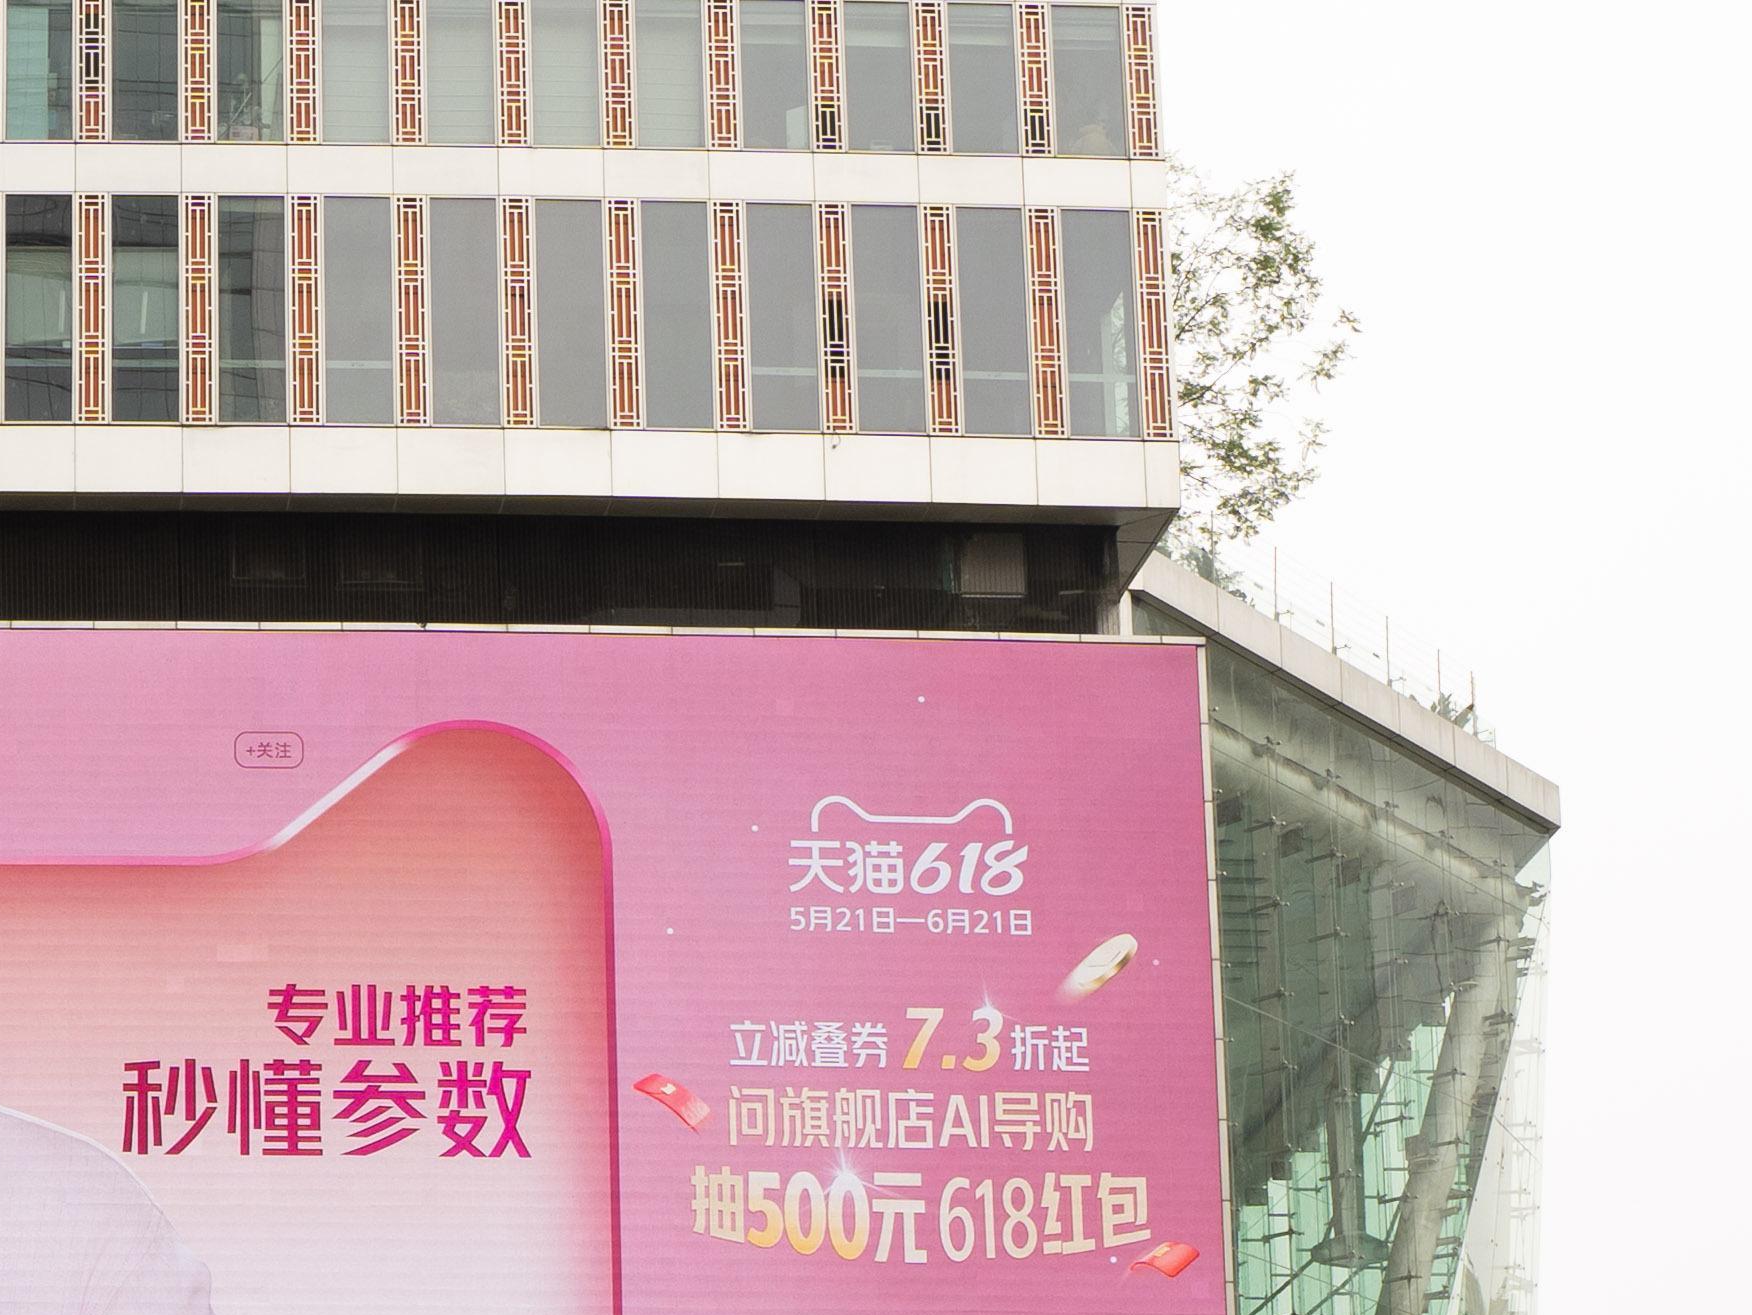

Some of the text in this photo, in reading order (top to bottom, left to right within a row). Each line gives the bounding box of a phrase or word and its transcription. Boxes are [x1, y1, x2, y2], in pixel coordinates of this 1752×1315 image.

[788, 838, 1029, 896] 天猫618
[267, 983, 528, 1047] 专业推荐
[122, 1058, 532, 1159] 秒懂参数
[728, 1086, 1094, 1152] 问旗舰店AI导购
